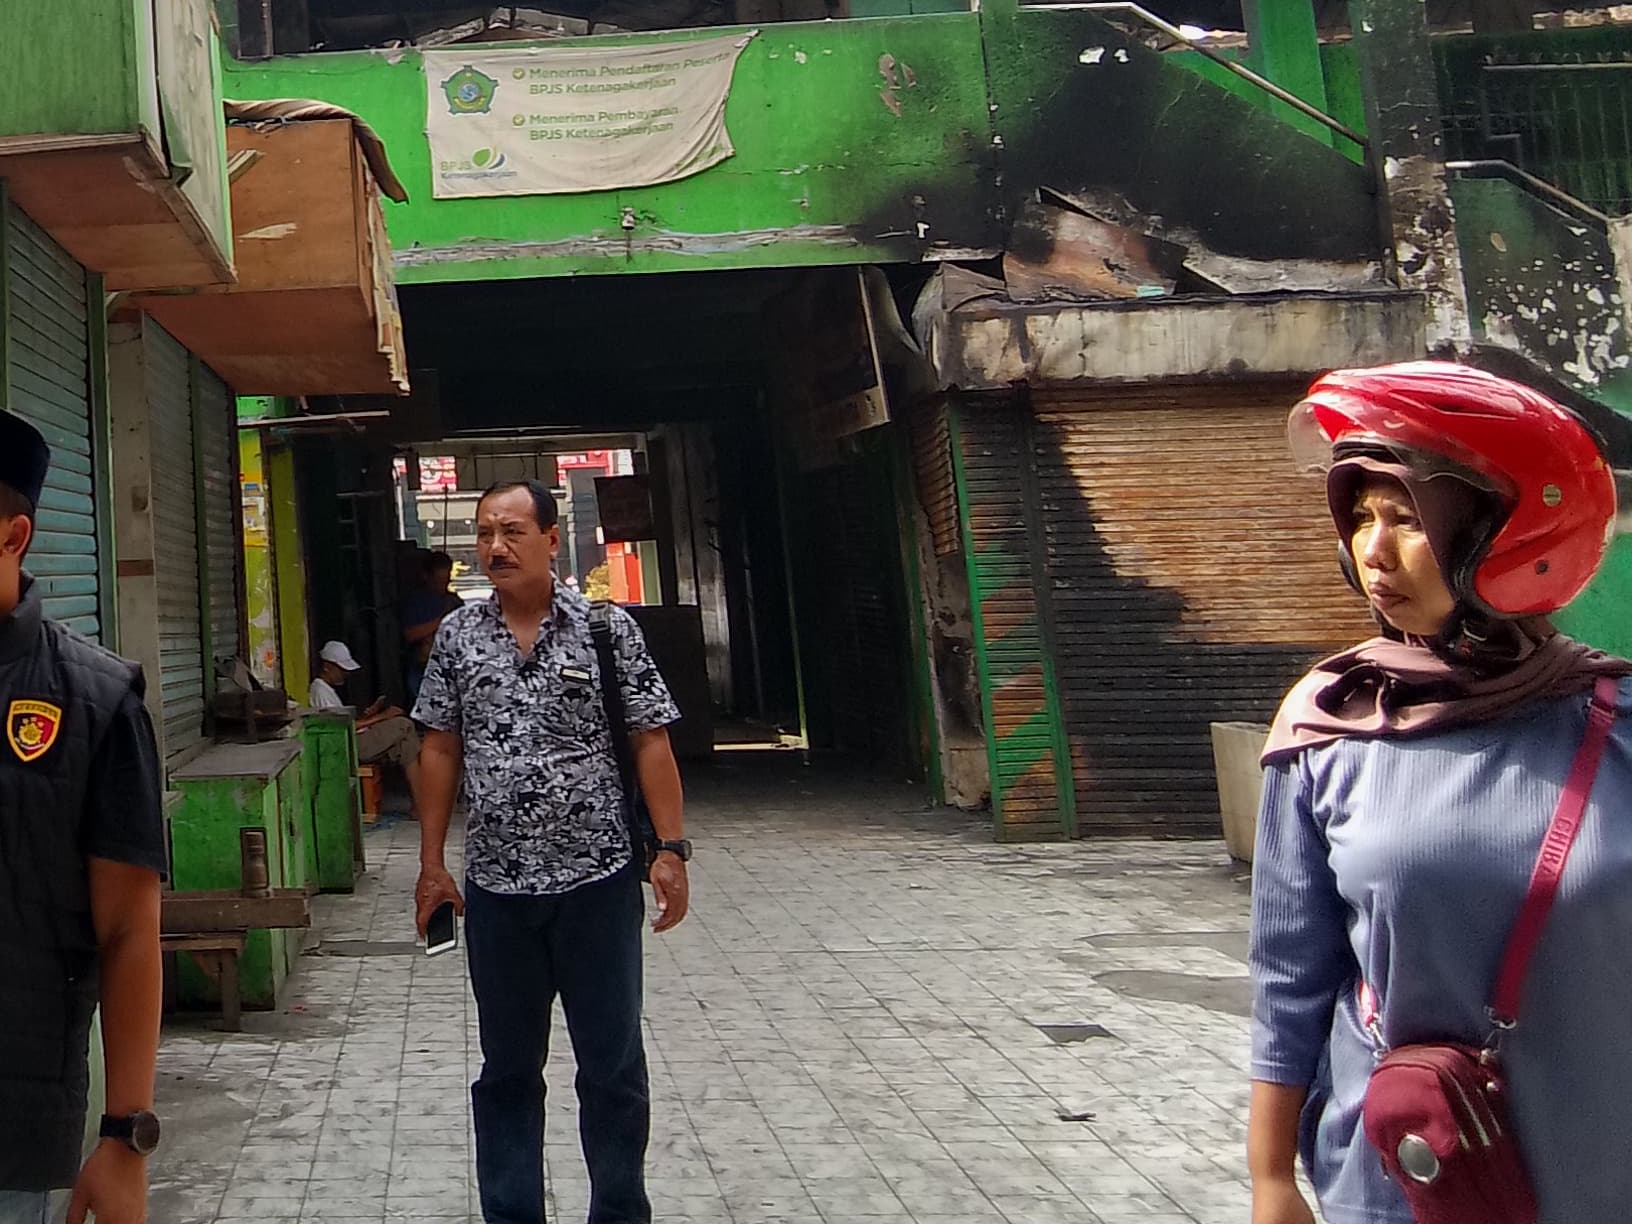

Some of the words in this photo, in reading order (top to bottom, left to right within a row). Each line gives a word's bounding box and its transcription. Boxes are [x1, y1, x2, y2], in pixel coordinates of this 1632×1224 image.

[529, 67, 597, 79] Menerima
[600, 62, 681, 77] Pendaftaran
[683, 51, 730, 70] Peserta
[529, 83, 563, 95] BPJS
[566, 77, 676, 94] Ketenagakerjaan
[529, 113, 596, 125] Menerima
[598, 106, 679, 123] Pembayaran
[529, 129, 562, 141] BPJS
[566, 122, 674, 139] Ketenagakerjaan
